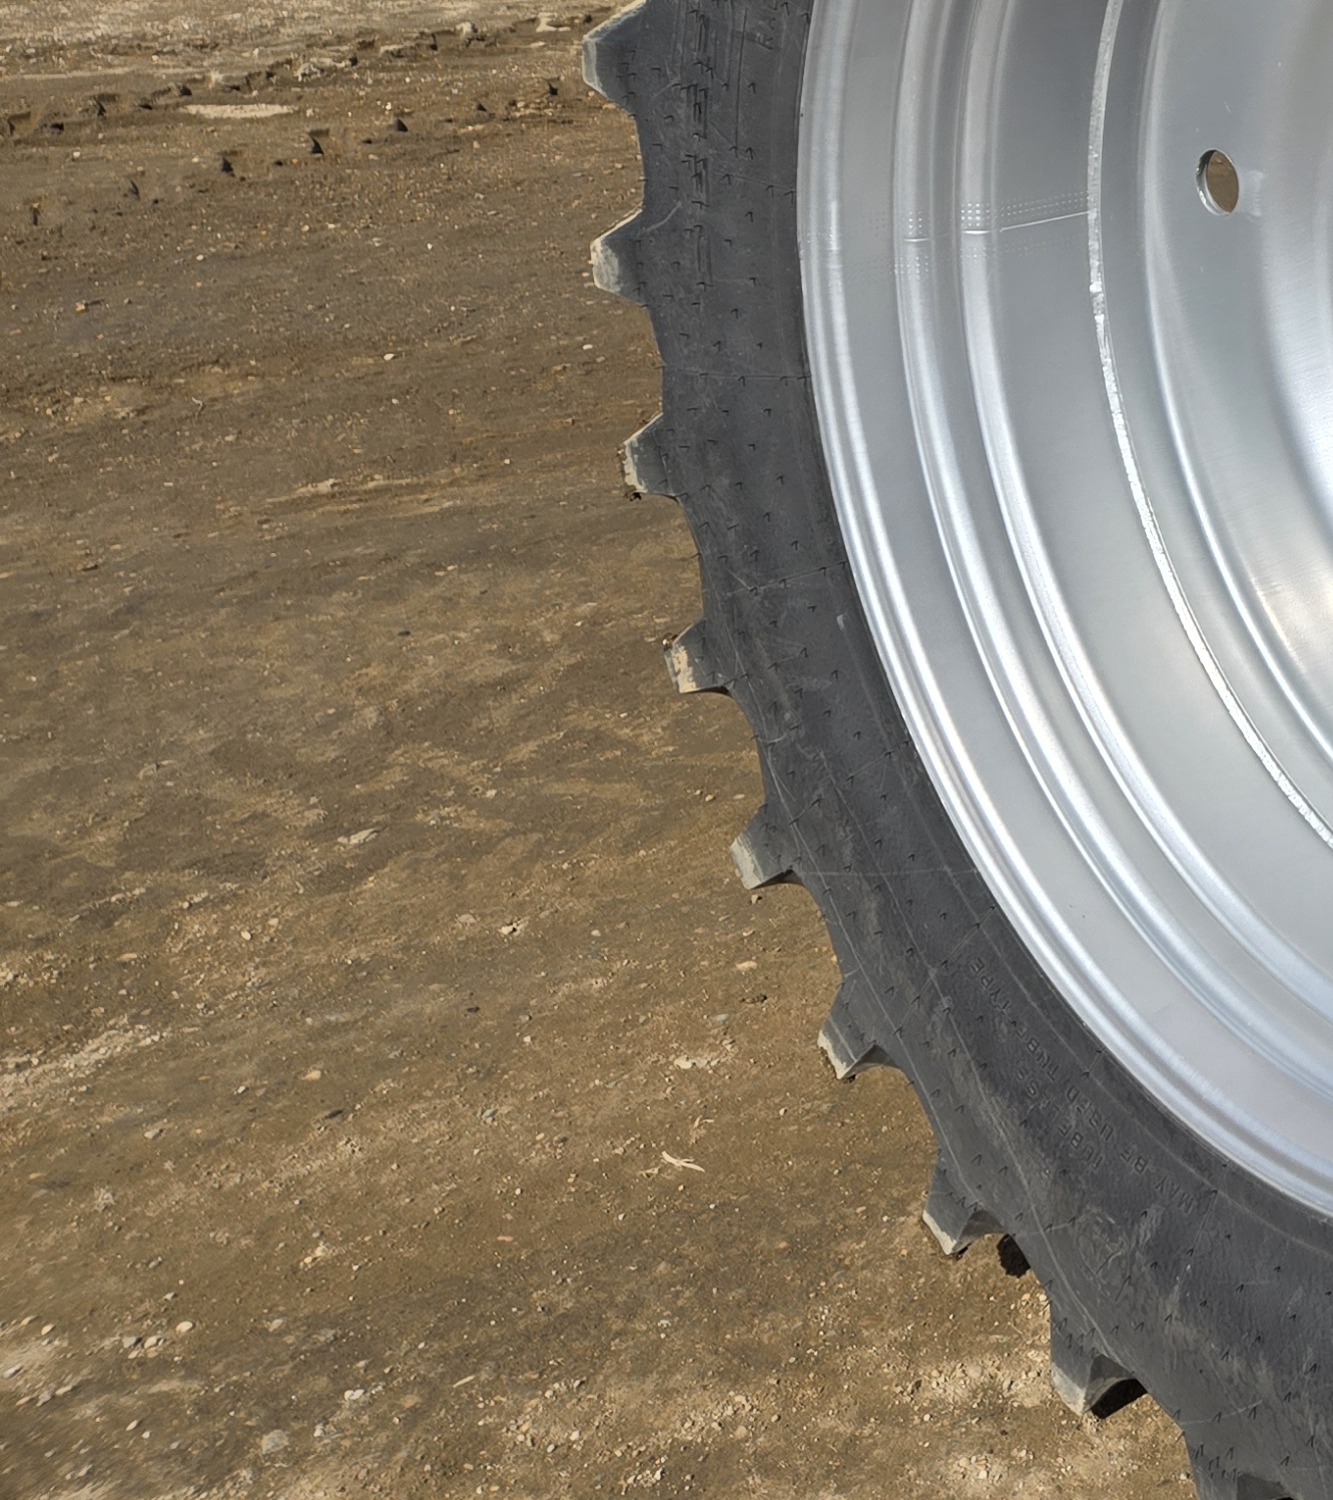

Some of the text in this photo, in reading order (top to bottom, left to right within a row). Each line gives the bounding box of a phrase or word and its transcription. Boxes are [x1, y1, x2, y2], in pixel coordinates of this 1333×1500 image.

[970, 955, 1192, 1214] MAY BE USED TUBE TYPE
[1014, 1065, 1102, 1170] TUBELESS
